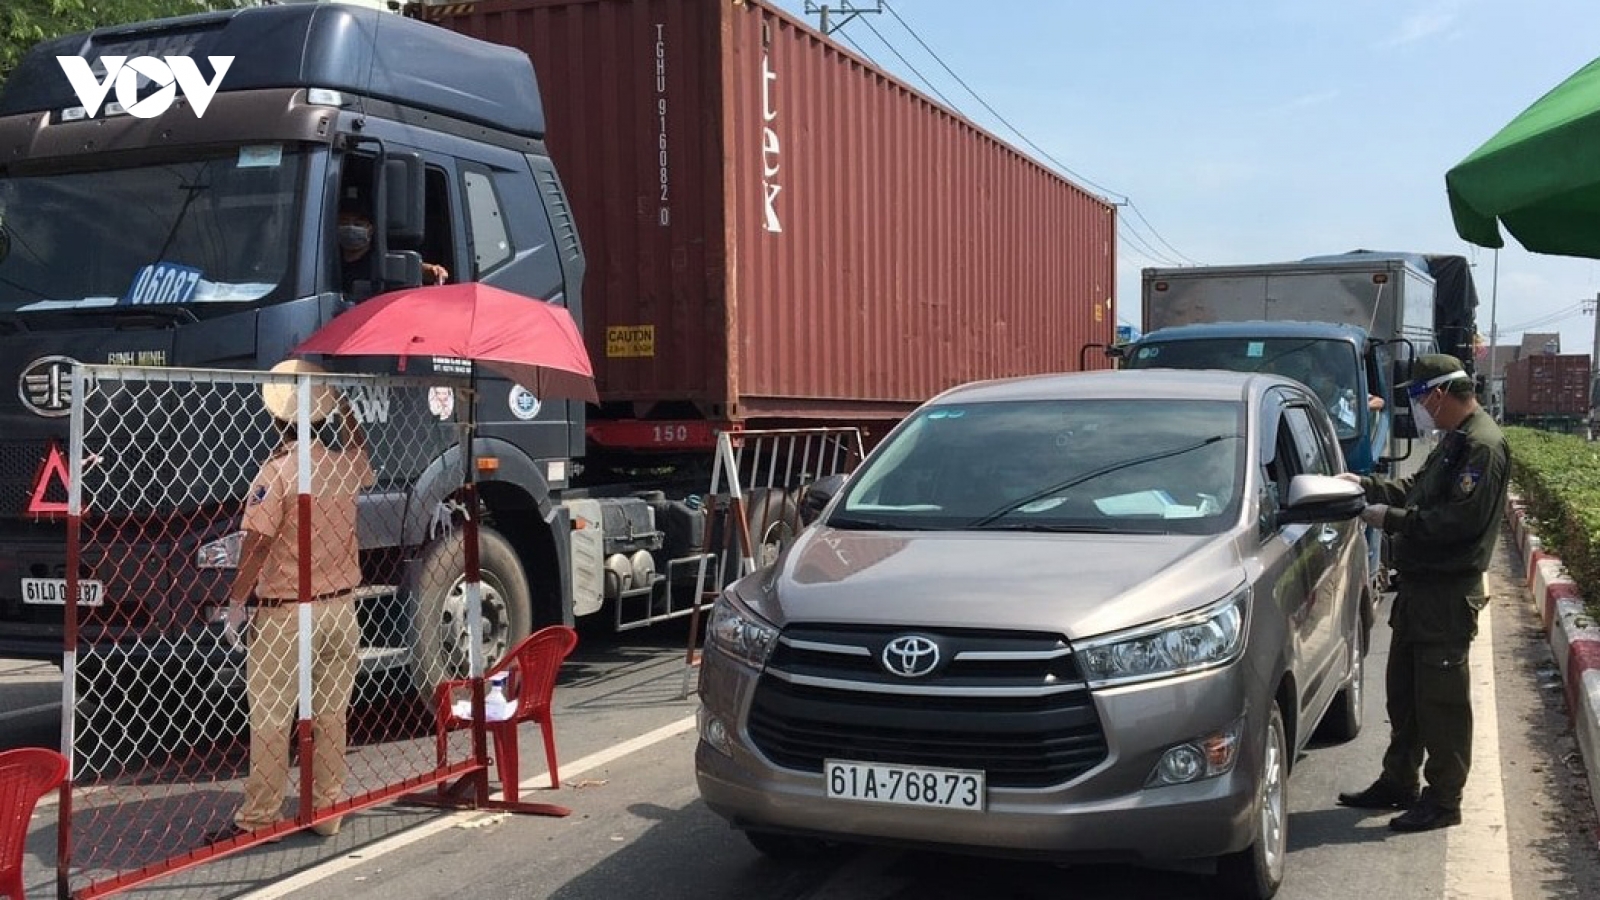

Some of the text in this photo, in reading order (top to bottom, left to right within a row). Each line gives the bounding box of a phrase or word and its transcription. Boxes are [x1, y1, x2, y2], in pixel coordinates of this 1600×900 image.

[656, 23, 668, 225] TGHU 916082 0
[132, 264, 200, 305] 06087
[609, 328, 652, 343] CAUTON
[653, 425, 687, 441] 150
[831, 766, 977, 806] 61A-768.73
